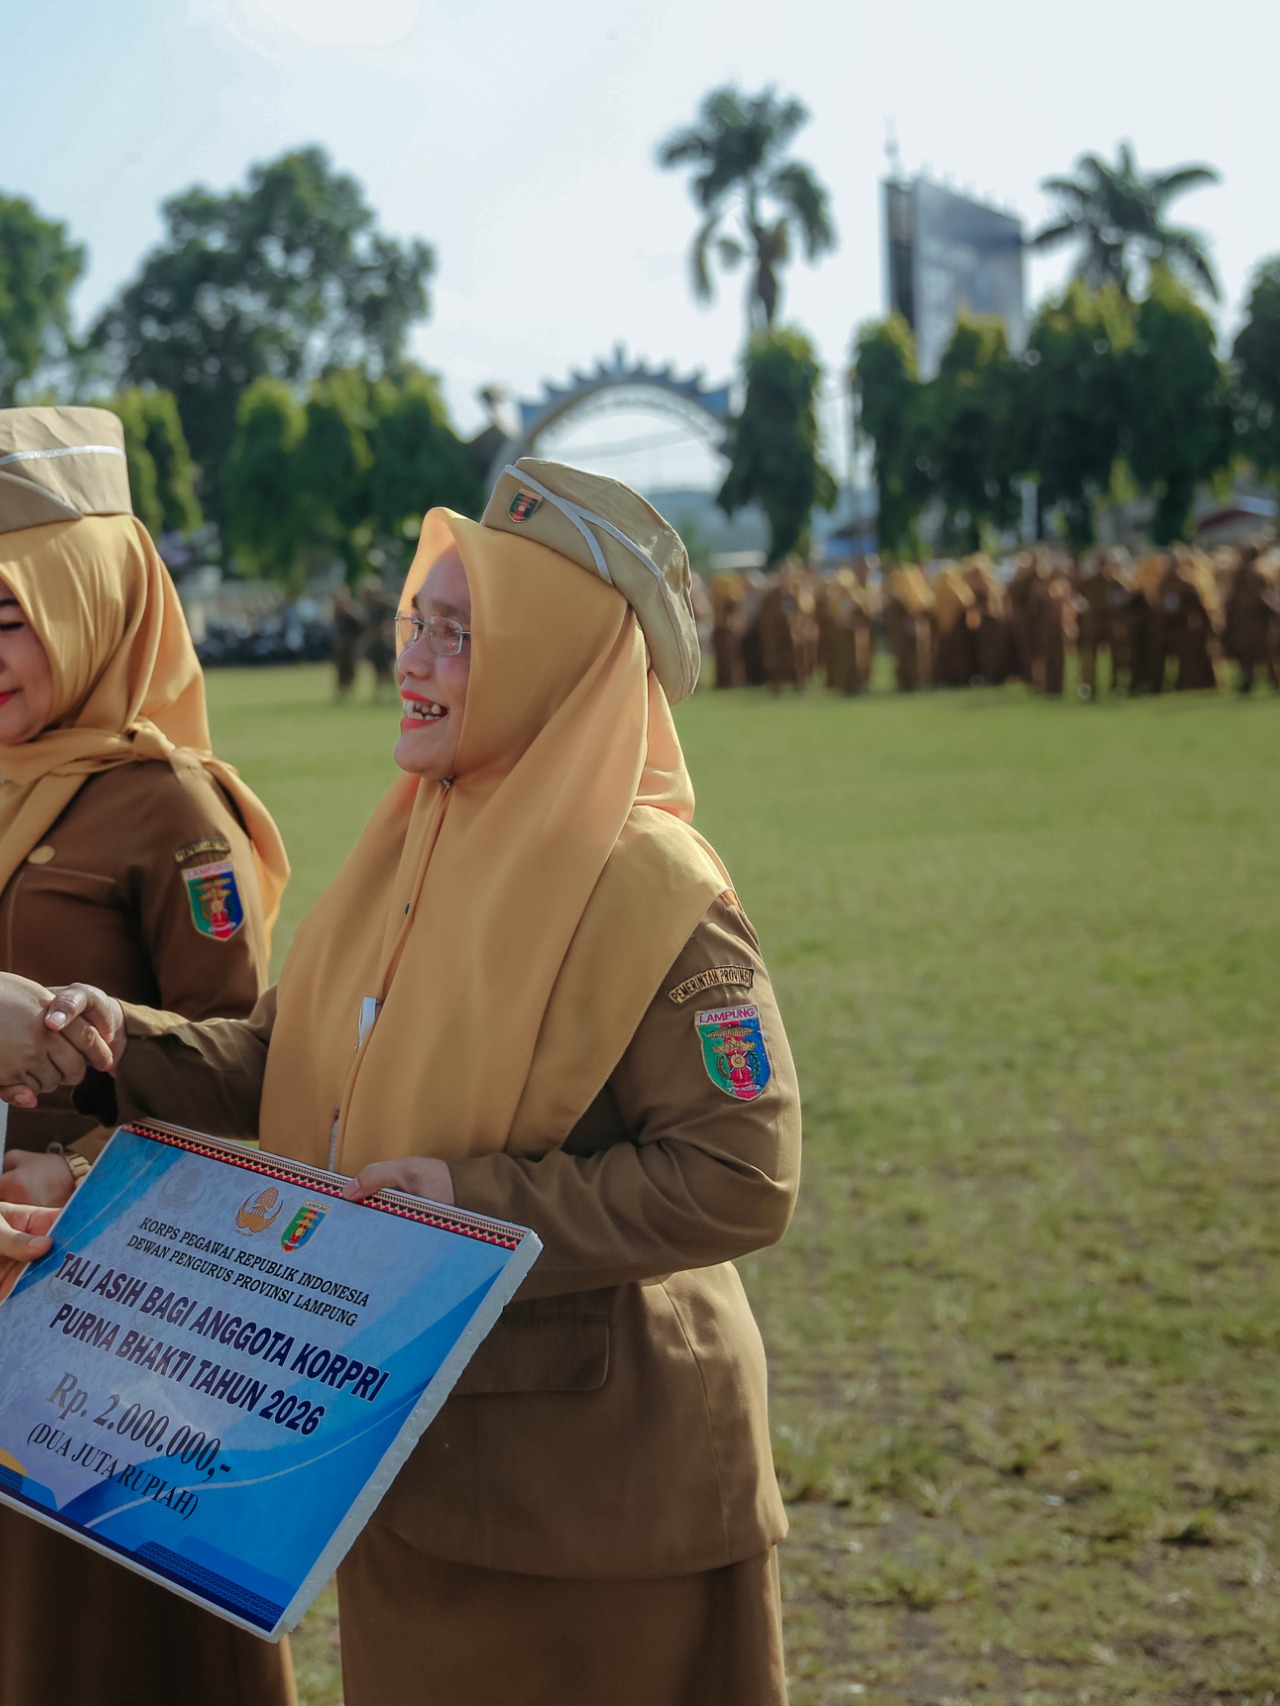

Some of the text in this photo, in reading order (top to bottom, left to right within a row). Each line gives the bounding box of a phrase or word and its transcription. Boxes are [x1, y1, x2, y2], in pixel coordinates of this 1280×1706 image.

[671, 968, 752, 1002] PEMERINTAH PROVINSI
[699, 1007, 755, 1023] LAMPUNG
[127, 1234, 358, 1327] DEWAN PENGURUS PROVINSI LAMPUNG
[139, 1217, 370, 1307] KORPS PEGAWAI REPUBLIK INDONESIA
[48, 1302, 326, 1437] PURNA BHAKTI TAHUN 2026
[54, 1251, 390, 1402] TALI ASIH BAGI ANGGOTA KORPRI
[27, 1422, 199, 1521] (DUA JUTA RUPIAH)
[46, 1371, 231, 1483] Rp. 2.000.000,-
